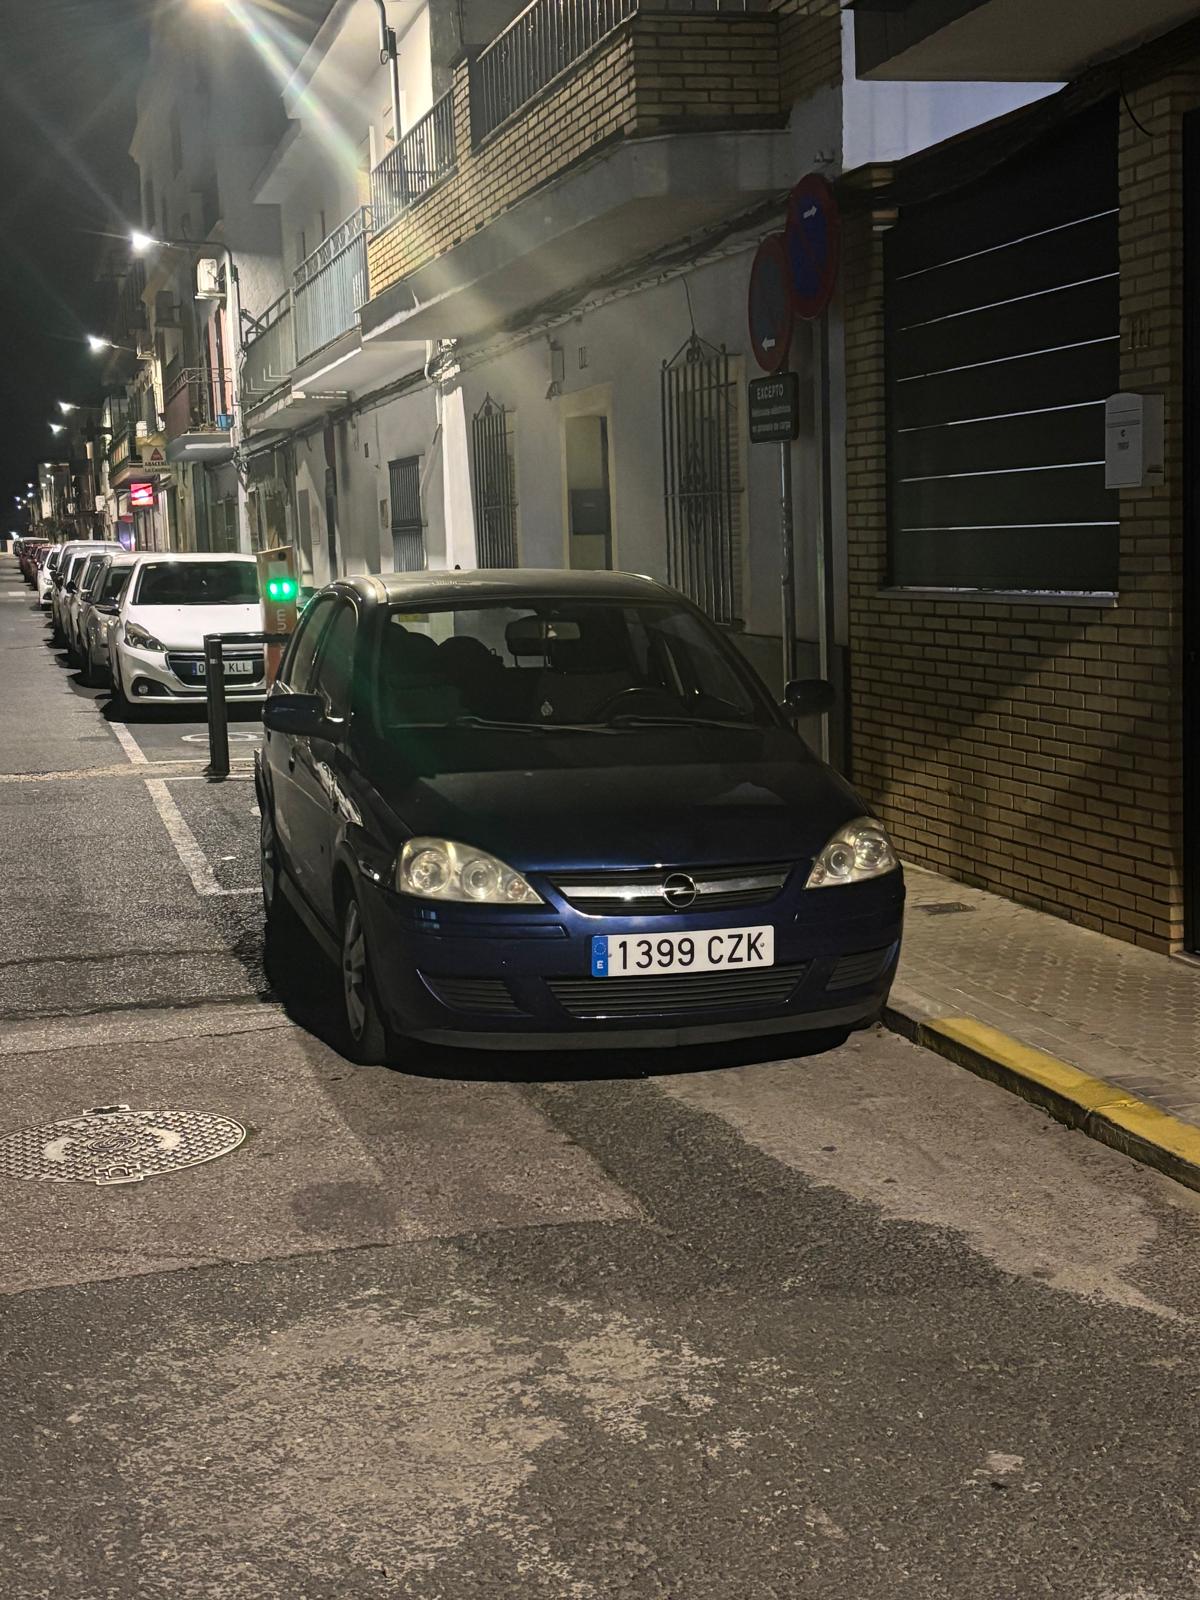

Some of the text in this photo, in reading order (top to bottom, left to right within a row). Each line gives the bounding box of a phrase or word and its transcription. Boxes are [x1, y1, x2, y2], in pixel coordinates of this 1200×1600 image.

[757, 384, 783, 400] EXCEPTO
[228, 662, 248, 672] KLL
[618, 932, 764, 970] 1399 CZK
[597, 961, 603, 969] E
